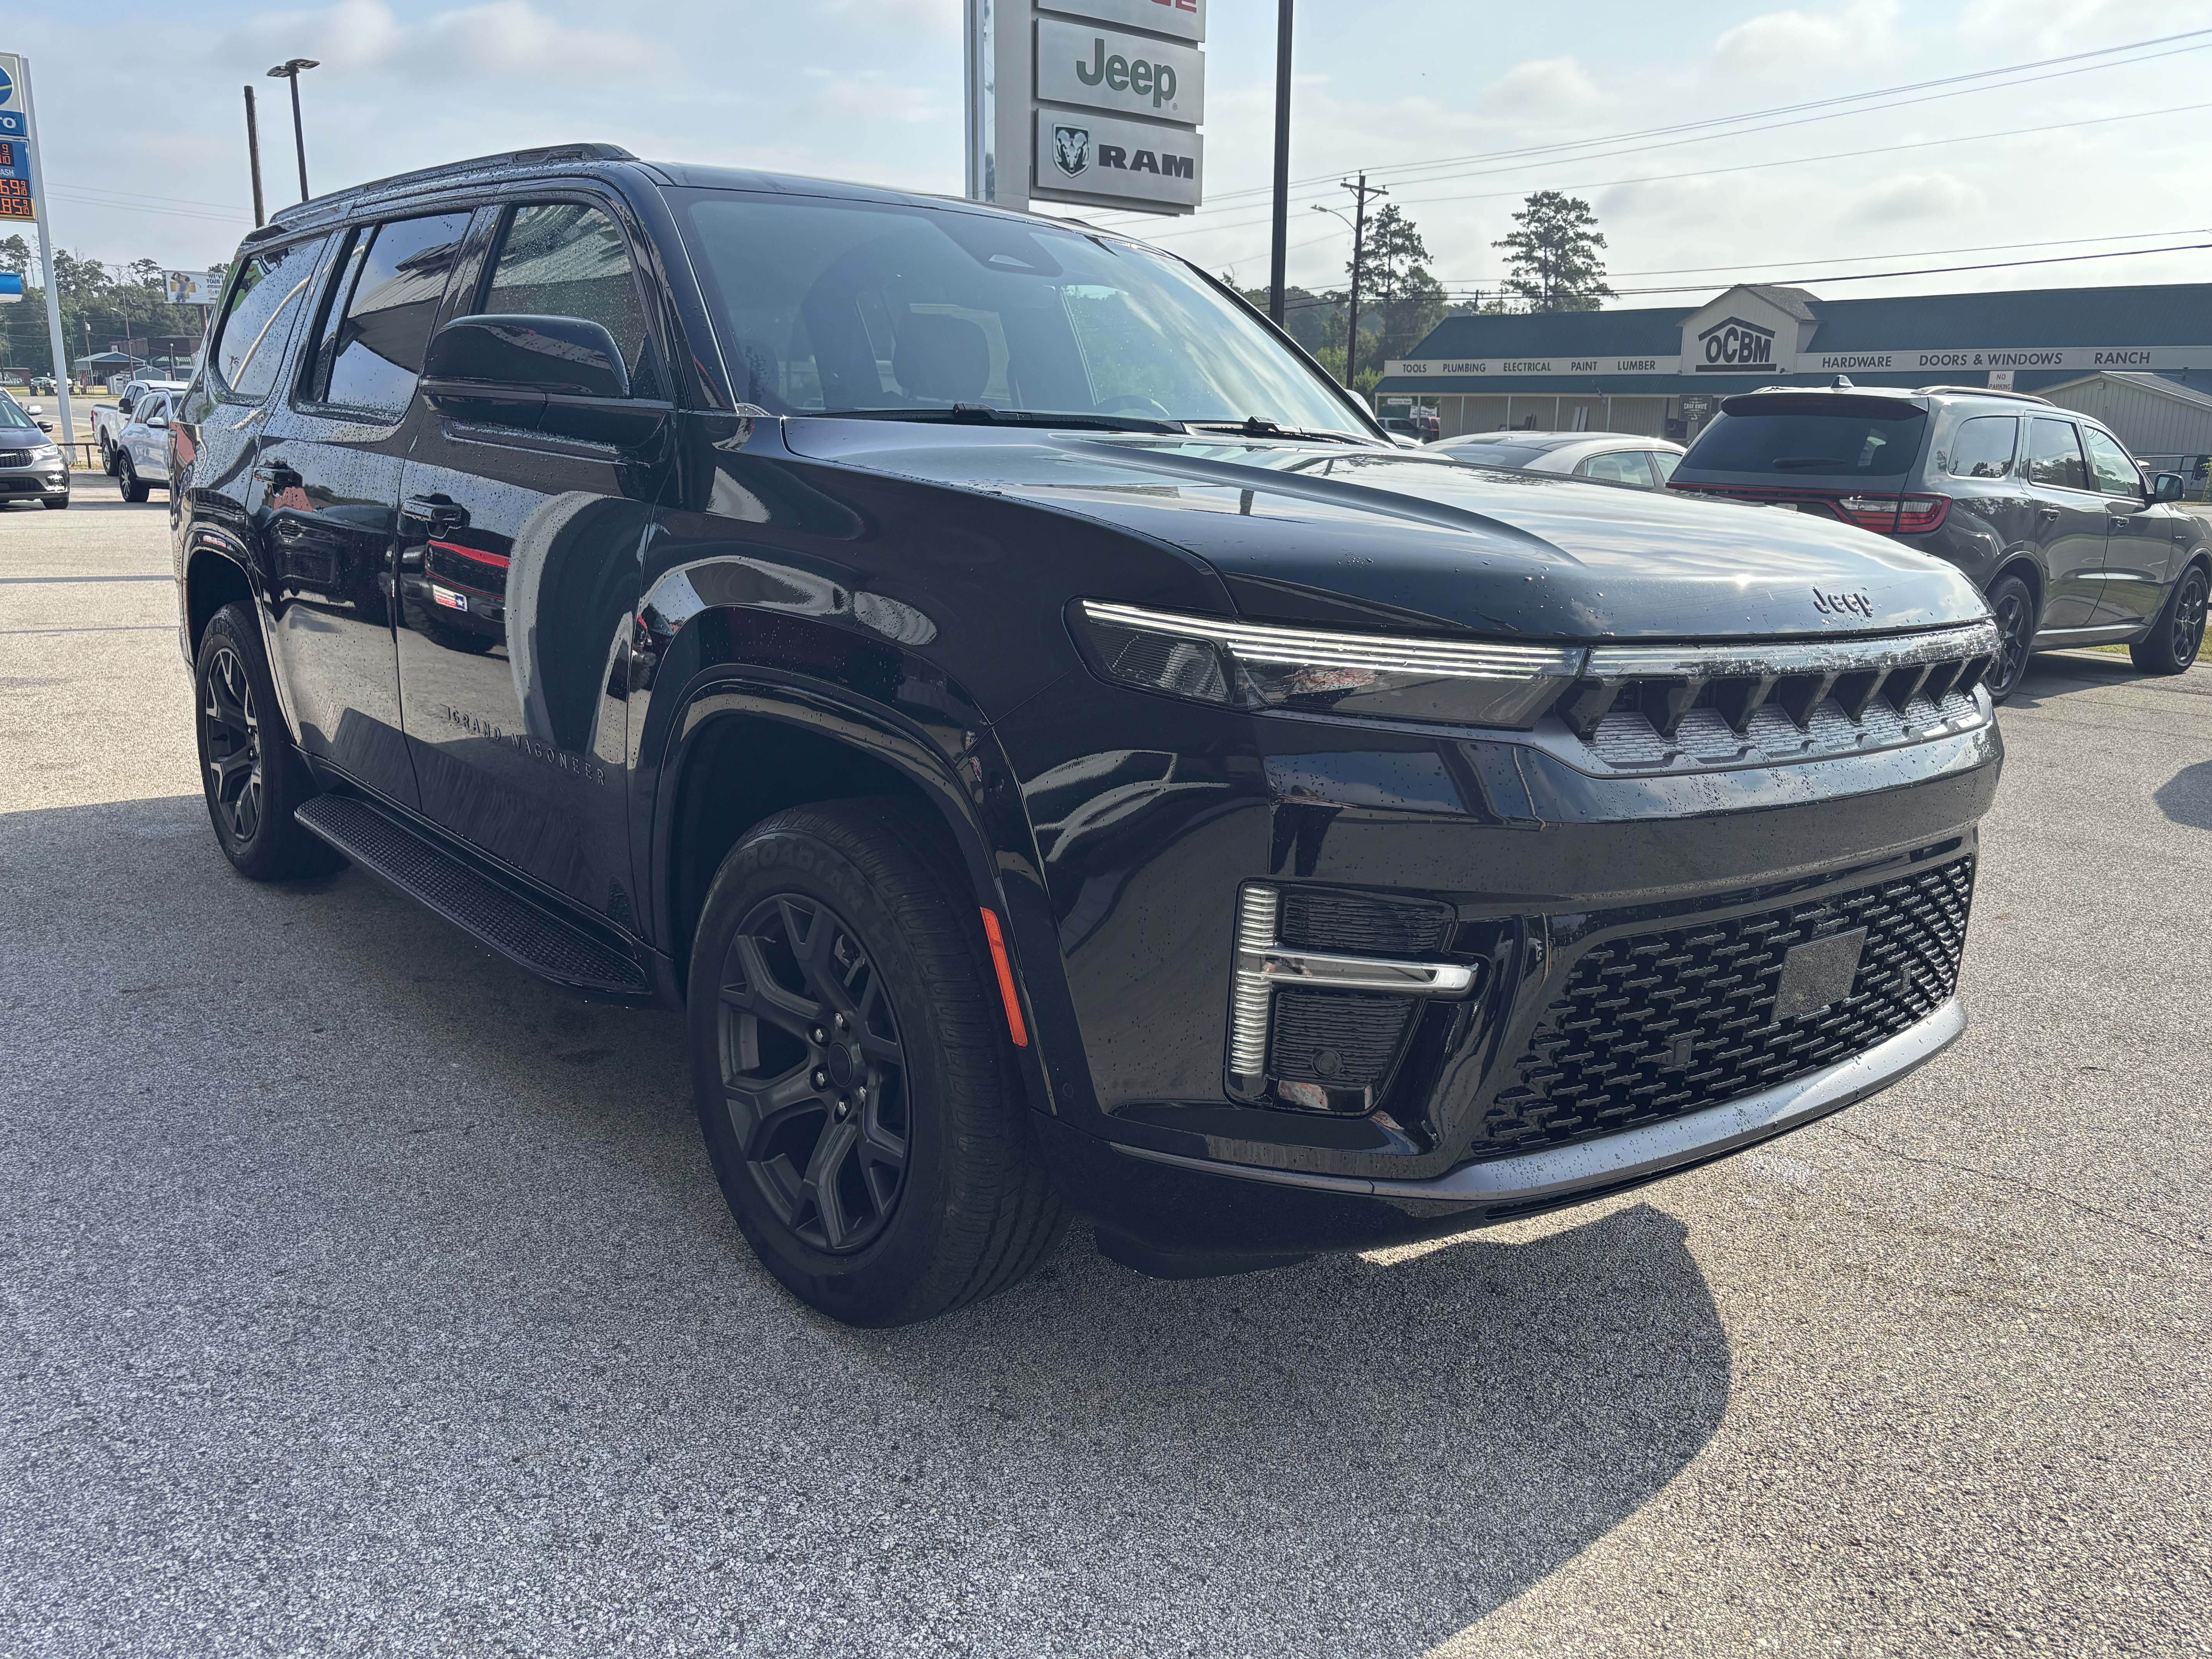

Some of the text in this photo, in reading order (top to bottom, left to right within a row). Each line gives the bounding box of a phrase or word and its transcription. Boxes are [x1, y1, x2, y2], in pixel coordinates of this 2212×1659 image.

[1076, 38, 1176, 108] Jeep
[1099, 144, 1194, 180] RAM
[1705, 327, 1771, 363] OCBM
[1822, 352, 2150, 368] HARDWARE DOORS & WINDOWS RANCH
[1403, 361, 1656, 373] TOOLS PLUMBING ELECTRICAL PAINT LUMBER
[1811, 584, 1874, 618] Jeep
[452, 708, 605, 786] GRAND WAGONEER
